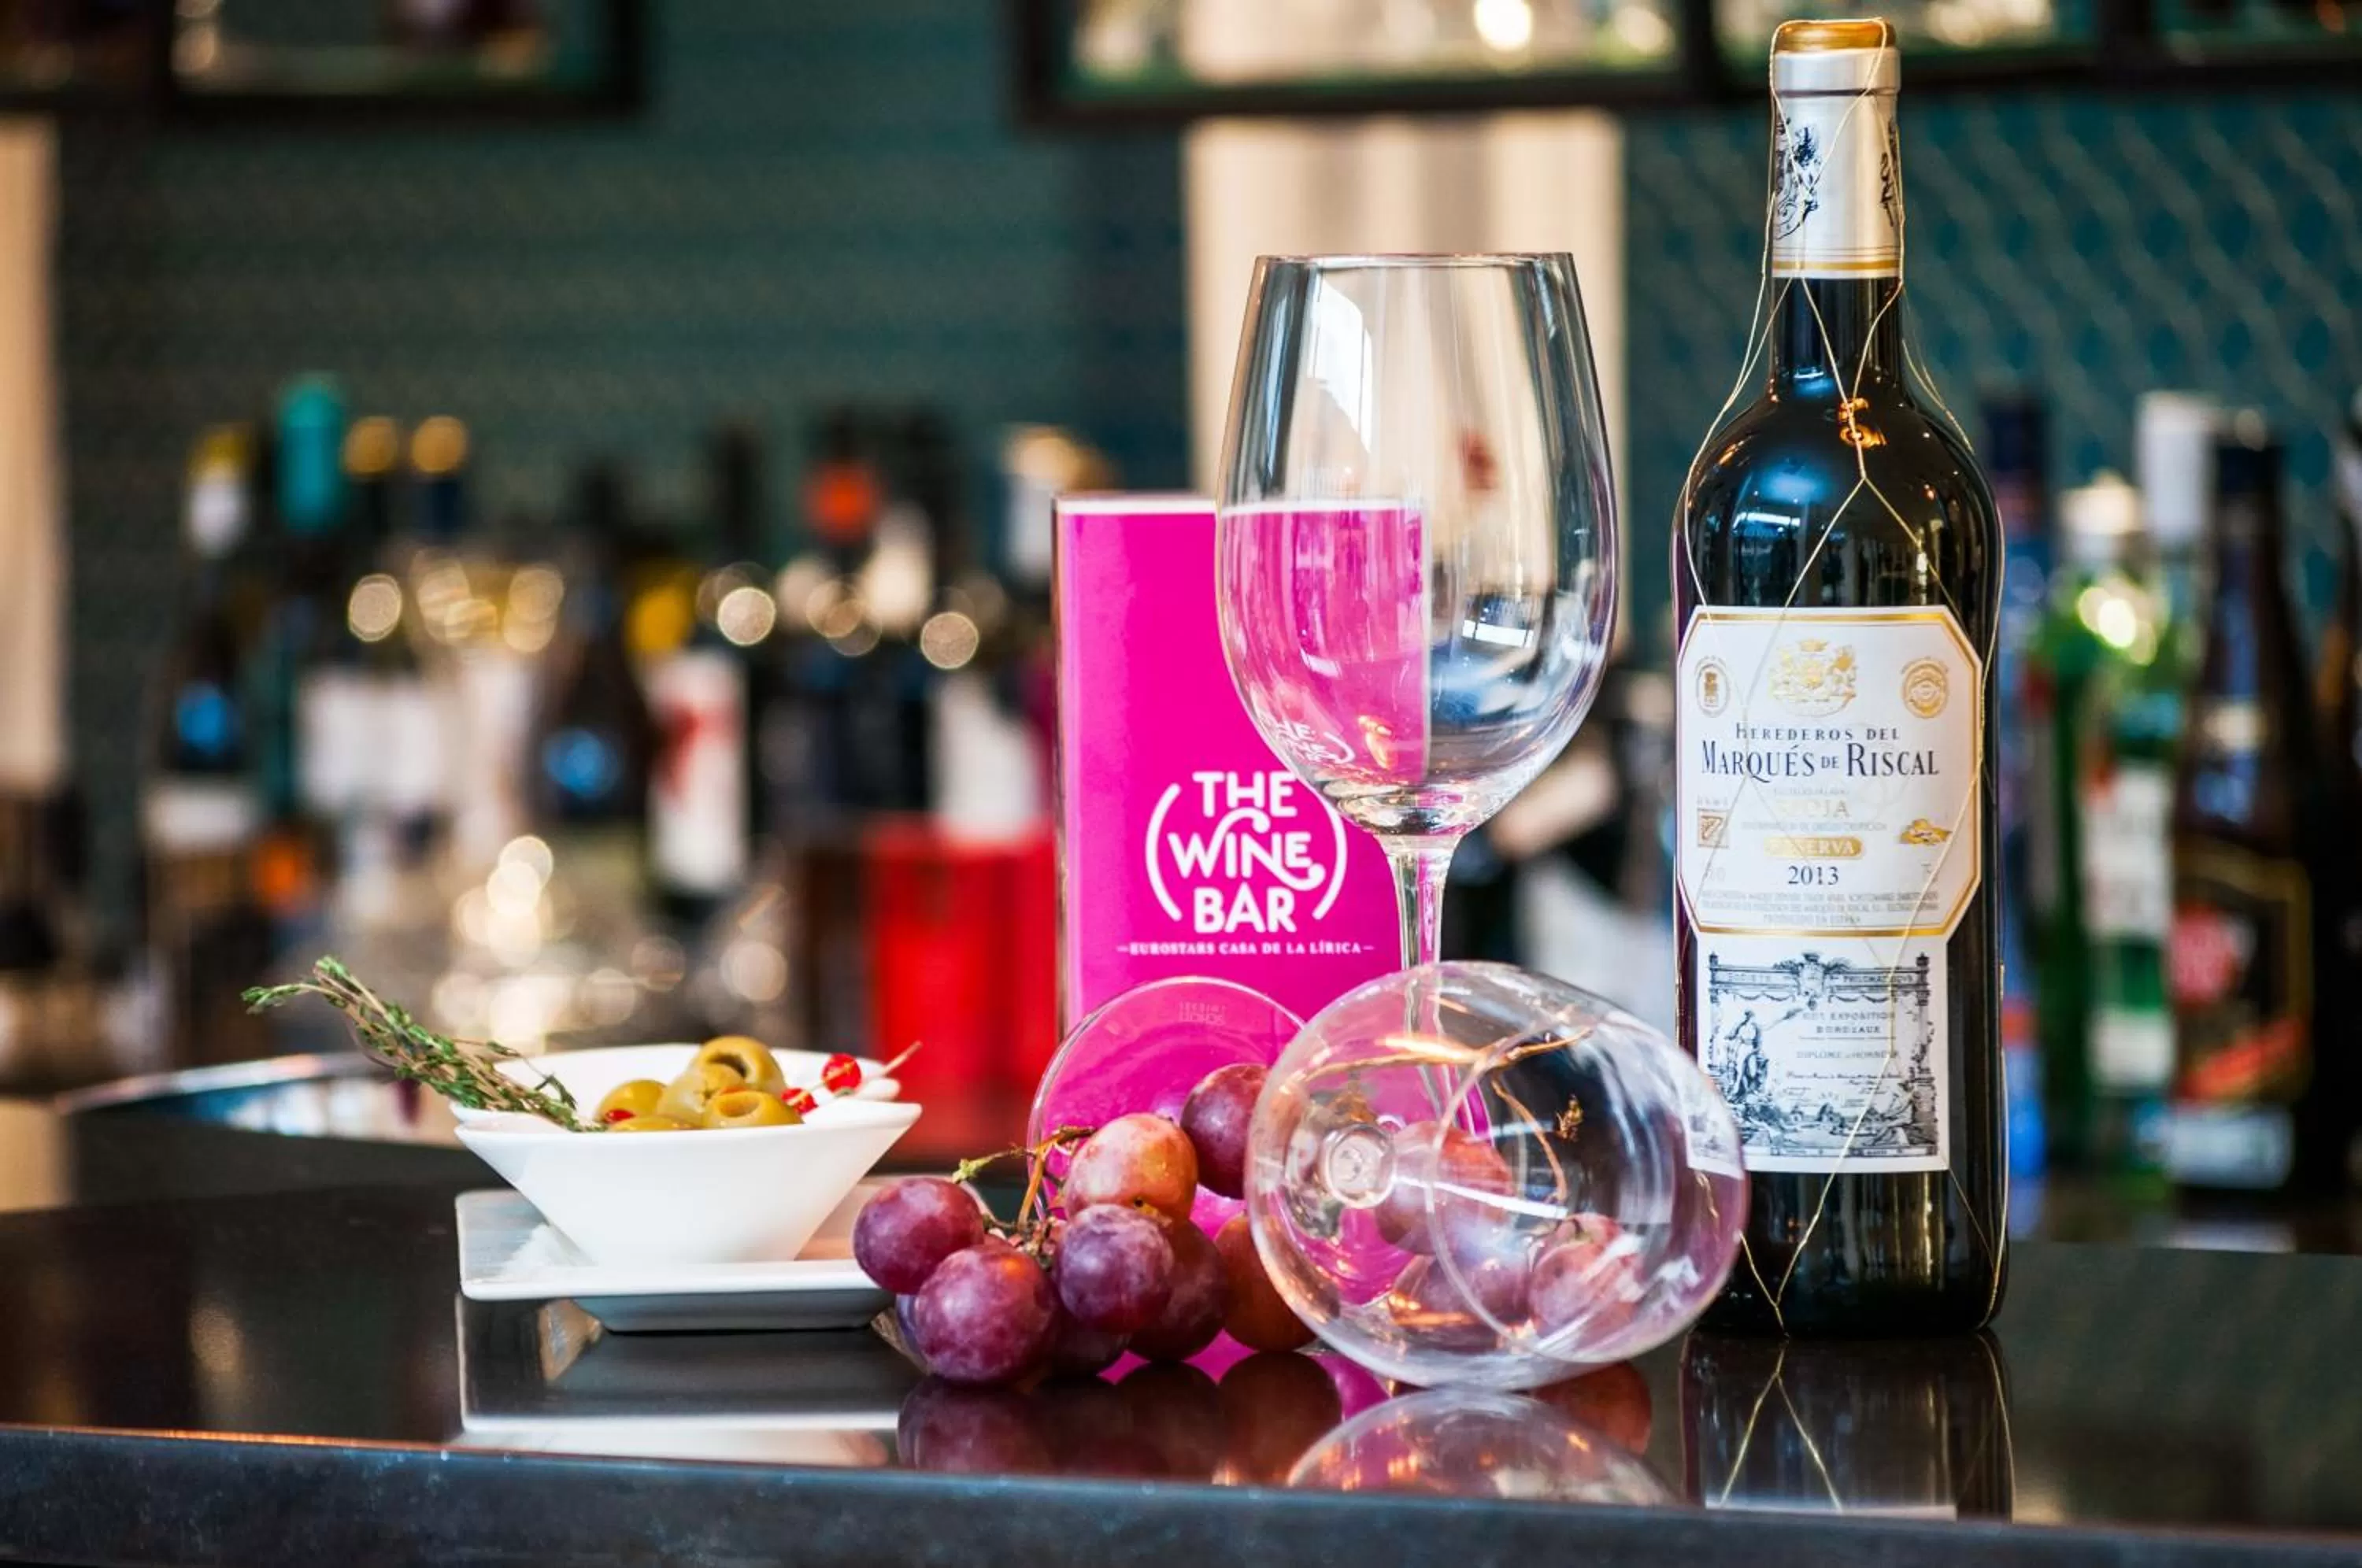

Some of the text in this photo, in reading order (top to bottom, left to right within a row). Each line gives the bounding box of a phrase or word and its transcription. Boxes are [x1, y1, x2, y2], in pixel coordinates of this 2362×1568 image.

[1736, 723, 1900, 741] HEREDEROS DEL
[1701, 740, 1940, 783] MARQUÉS DE RISCAL
[1192, 771, 1298, 818] THE
[1167, 806, 1327, 891] WINE
[1788, 865, 1839, 886] 2013
[1193, 881, 1298, 934] BAR
[1130, 940, 1361, 955] EUROSTARS CASA DE LA LÍRICA
[1830, 1011, 1895, 1020] EXPOSITIO
